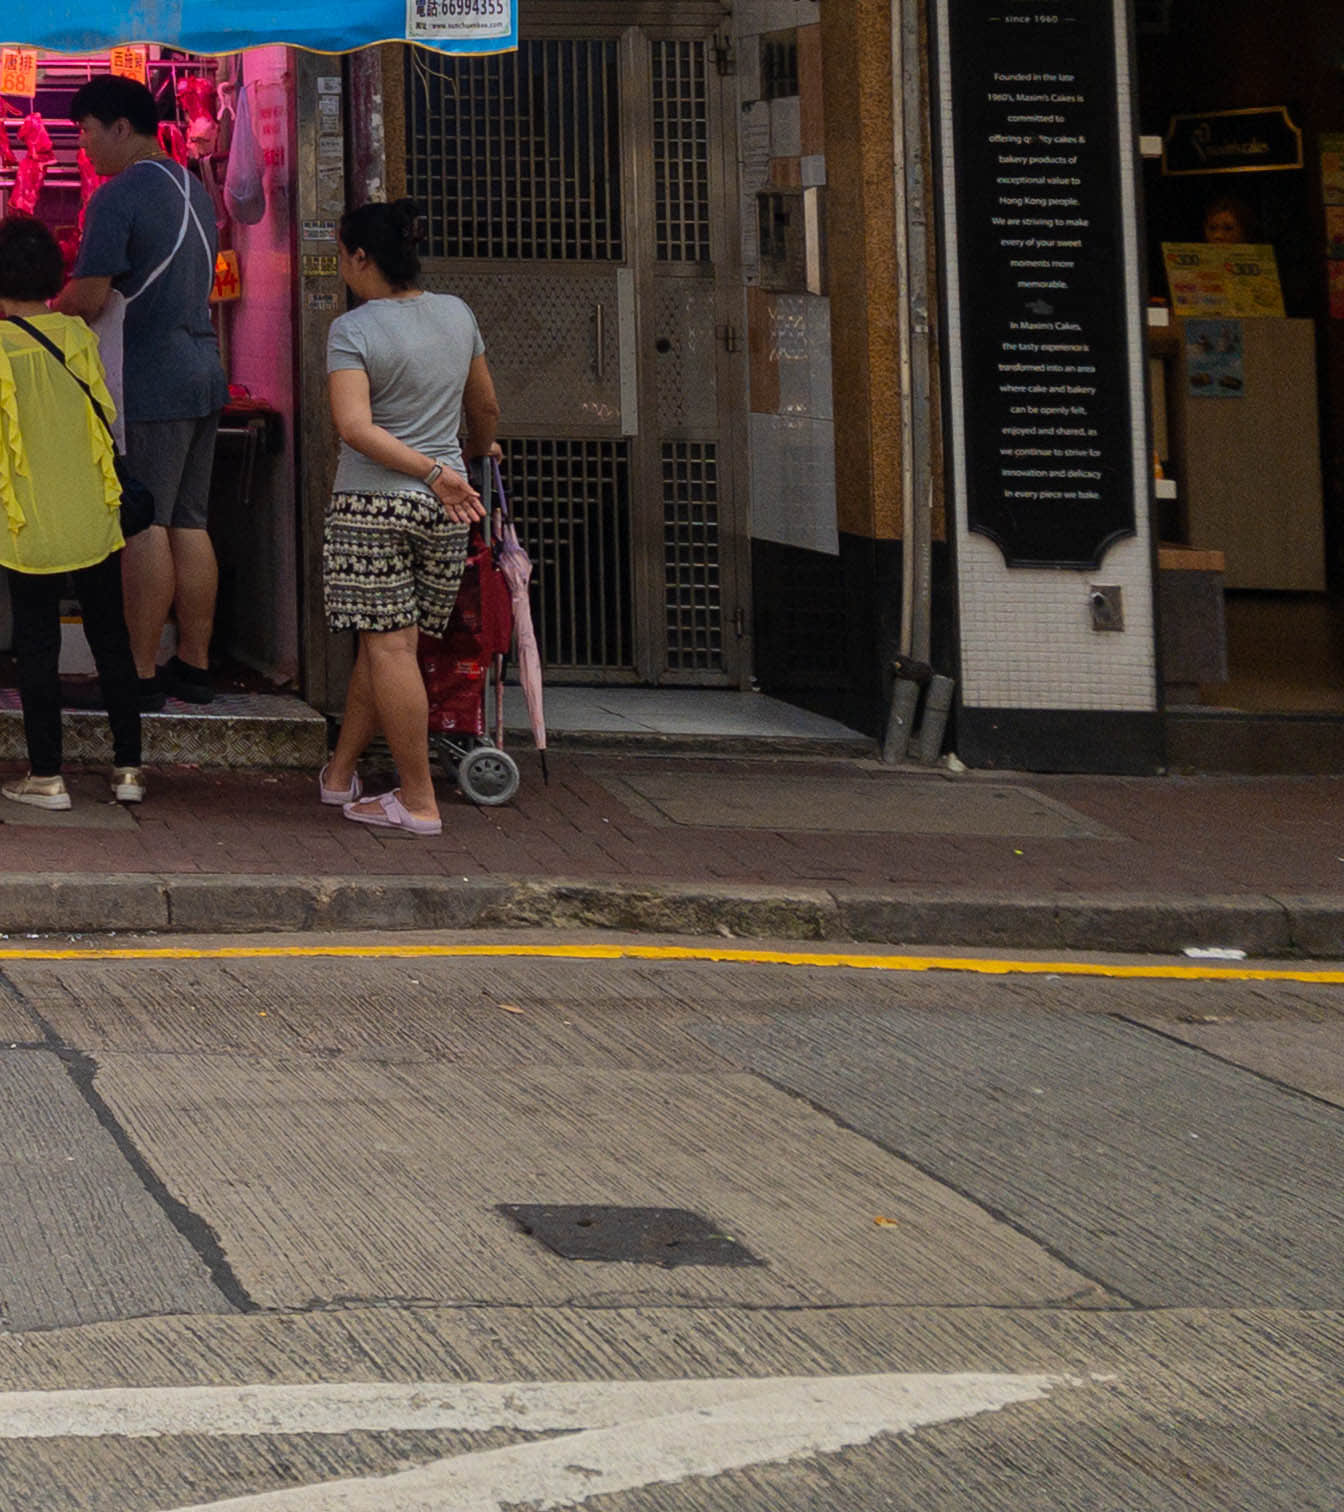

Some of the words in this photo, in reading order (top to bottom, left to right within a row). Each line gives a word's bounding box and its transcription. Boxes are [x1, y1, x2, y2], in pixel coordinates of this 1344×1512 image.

[1005, 15, 1031, 24] since
[1034, 15, 1059, 24] 1960
[4, 72, 25, 92] 68
[999, 196, 1023, 207] Hong
[1025, 196, 1047, 207] Kong
